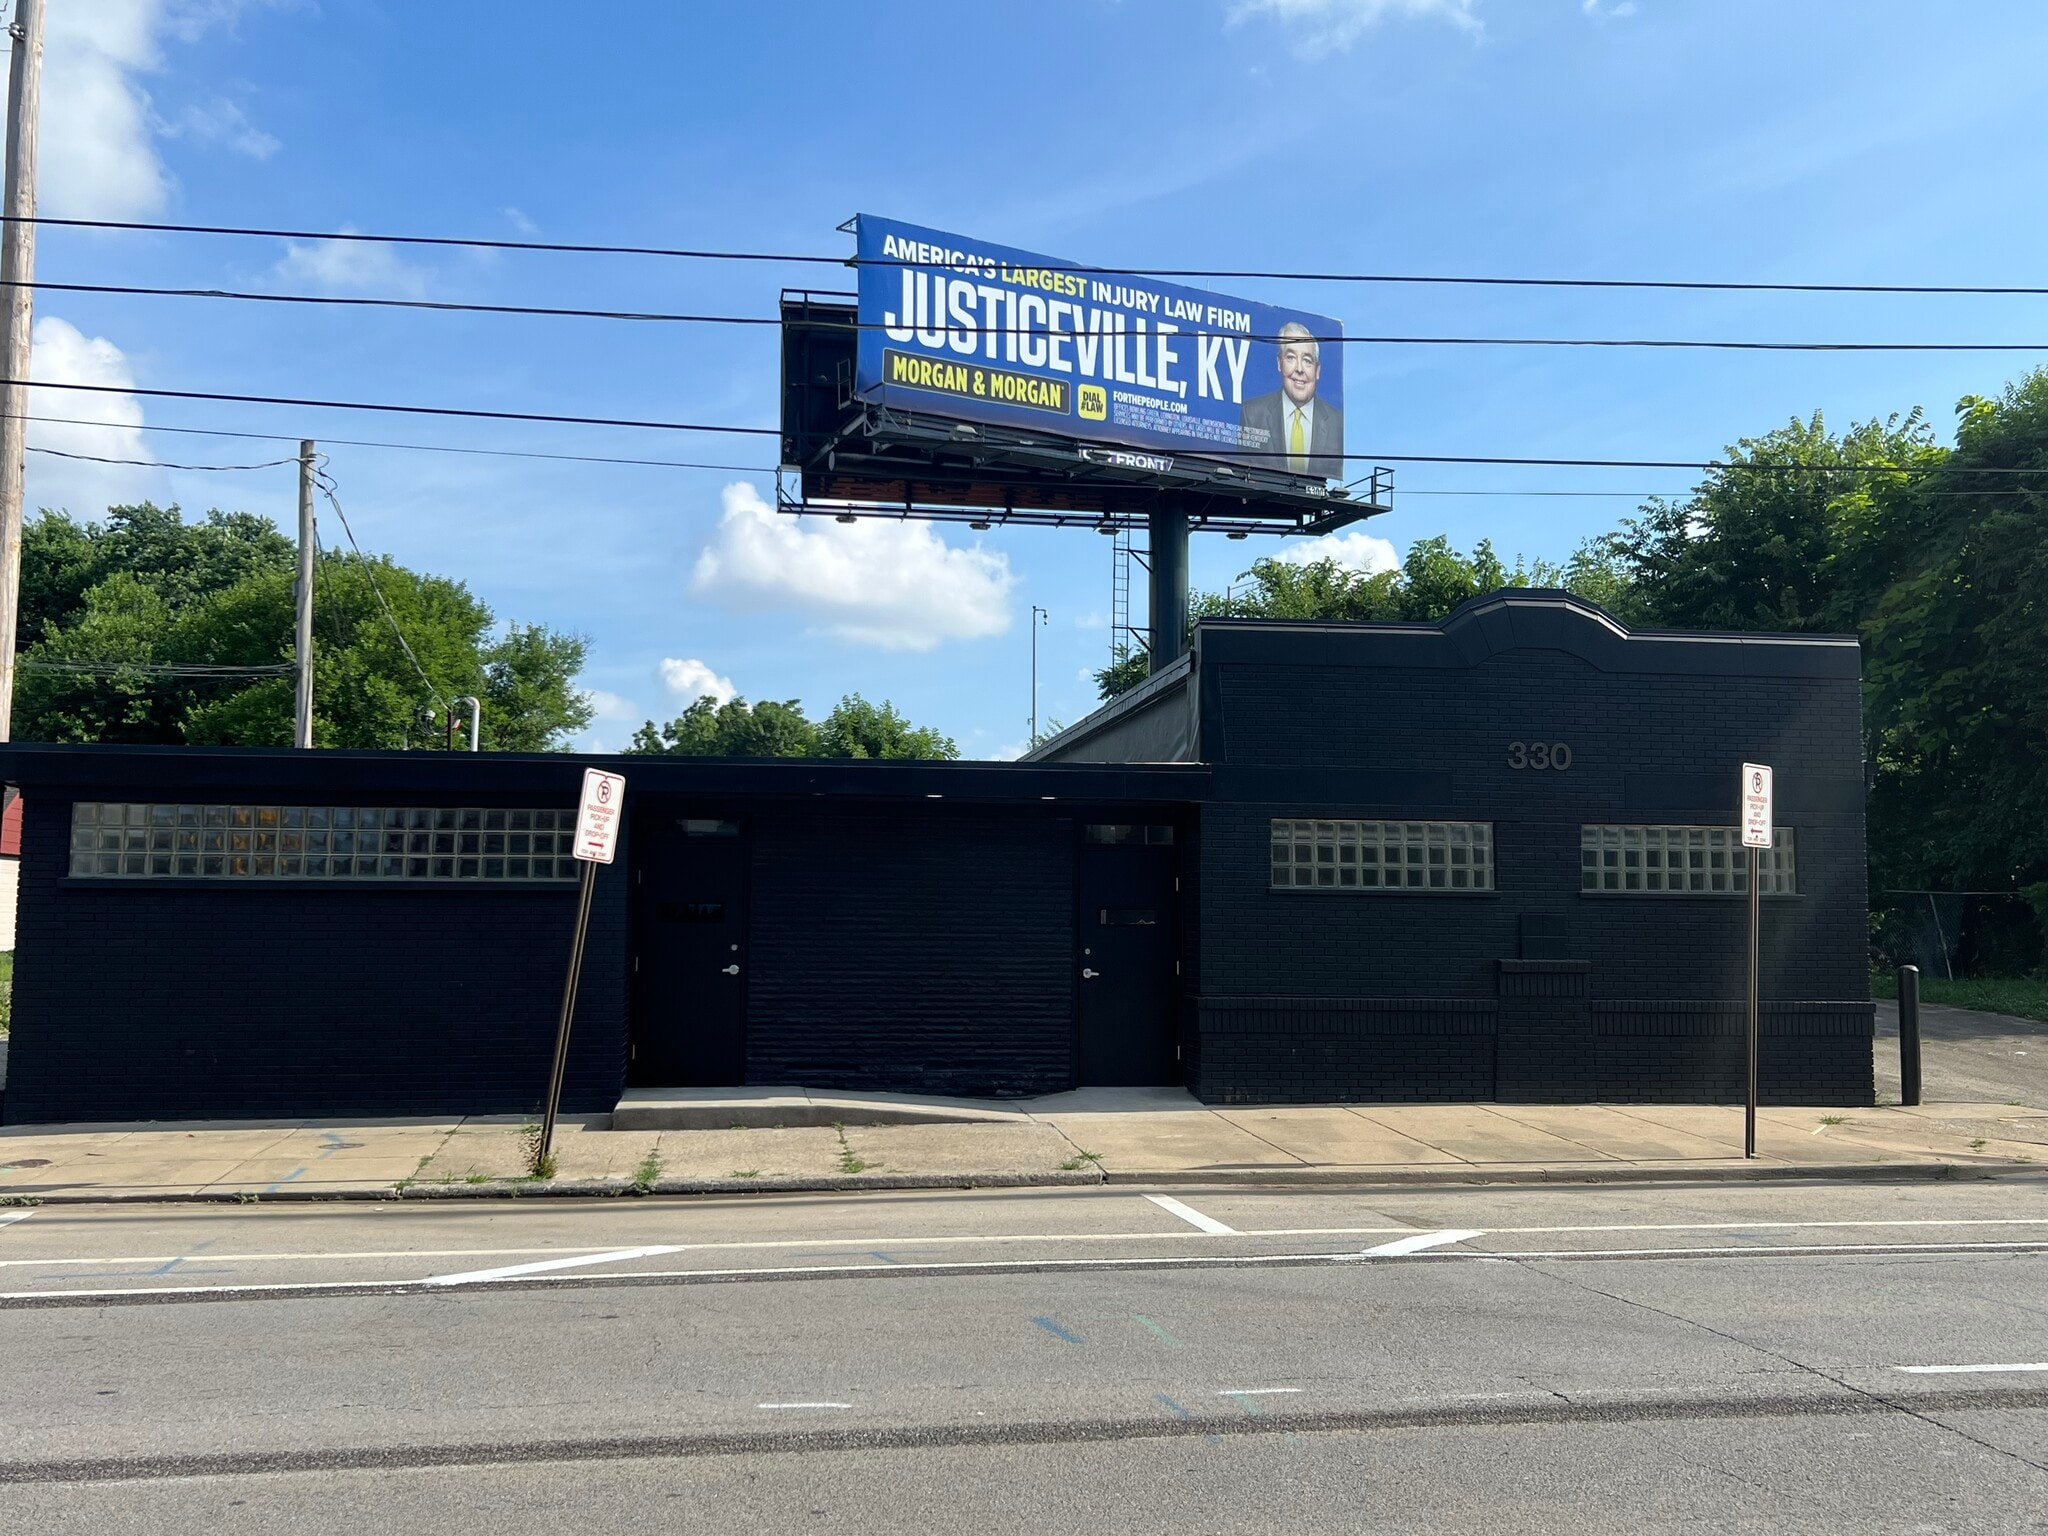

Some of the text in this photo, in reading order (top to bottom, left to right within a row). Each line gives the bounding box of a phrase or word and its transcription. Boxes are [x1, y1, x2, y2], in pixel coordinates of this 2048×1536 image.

[883, 234, 1250, 334] AMERICA'S LARGEST INJURY LAW FIRM
[884, 268, 1250, 405] JUSTICEVILLE, KY
[893, 355, 1062, 409] MORGAN & MORGAN
[1081, 400, 1104, 414] #LAW
[1083, 391, 1101, 403] DIAL
[1113, 390, 1188, 414] FORTHEPEOPLE.COM
[1507, 741, 1572, 771] 330
[594, 822, 604, 831] AND
